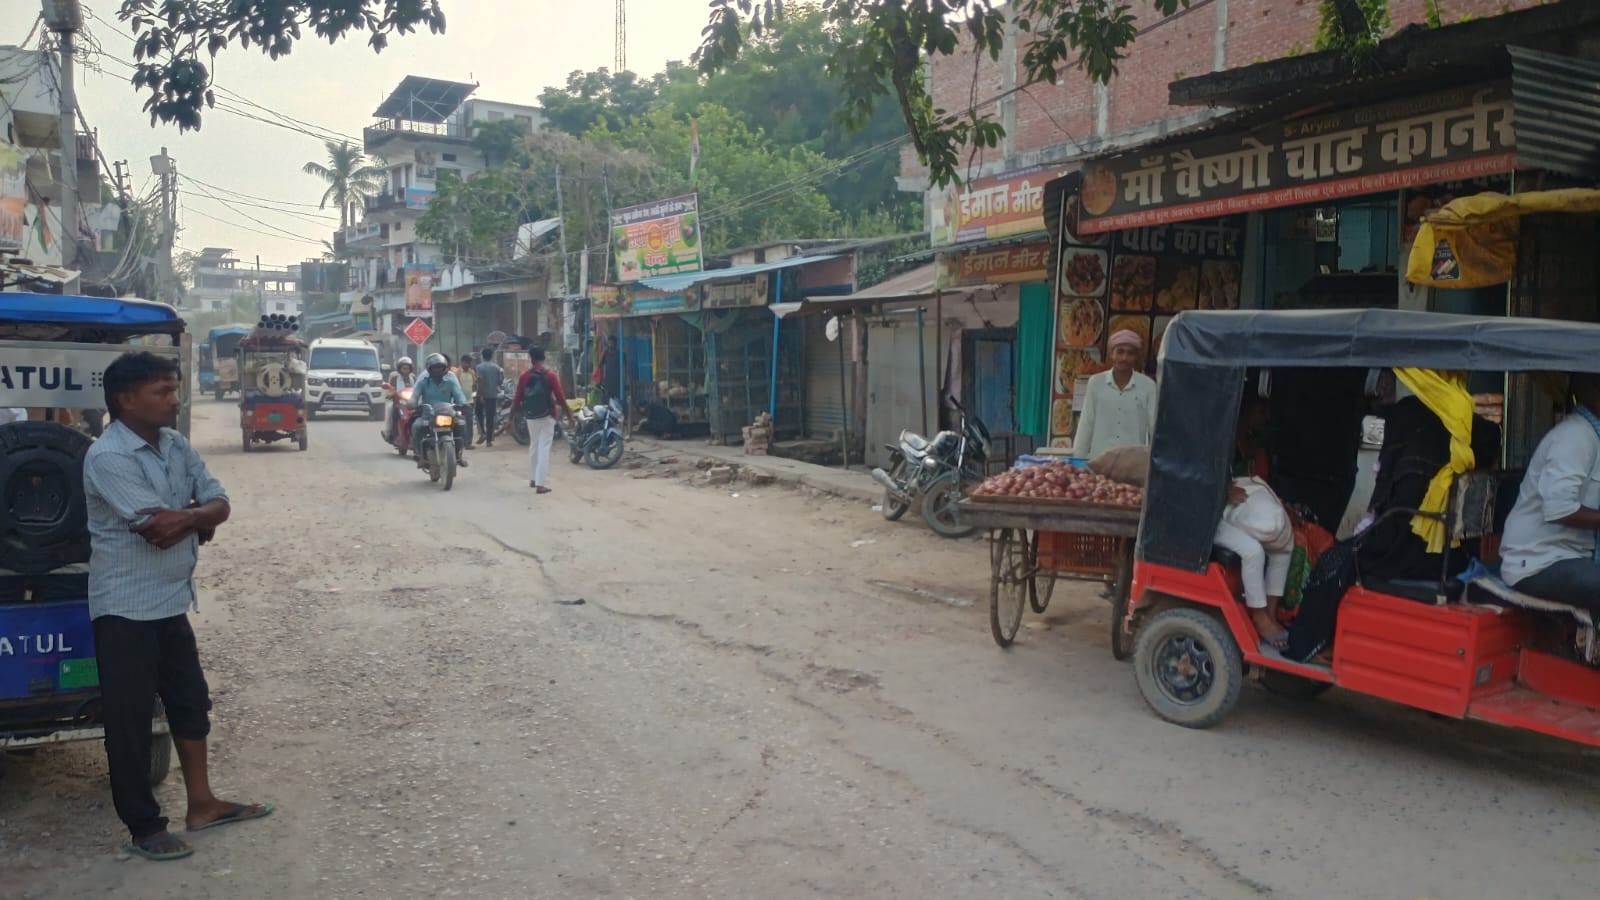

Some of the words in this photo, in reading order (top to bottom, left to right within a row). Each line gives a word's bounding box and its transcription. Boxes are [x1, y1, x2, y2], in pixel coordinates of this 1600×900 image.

[1121, 154, 1166, 206] माँ
[1170, 136, 1274, 198] वैष्णो
[1282, 126, 1368, 181] चाट
[960, 183, 1009, 225] ईमान
[1011, 180, 1043, 214] मीट
[964, 248, 1010, 275] ईमान
[1011, 247, 1041, 268] मीट
[0, 365, 83, 391] ATUL
[0, 633, 73, 656] ATUL
